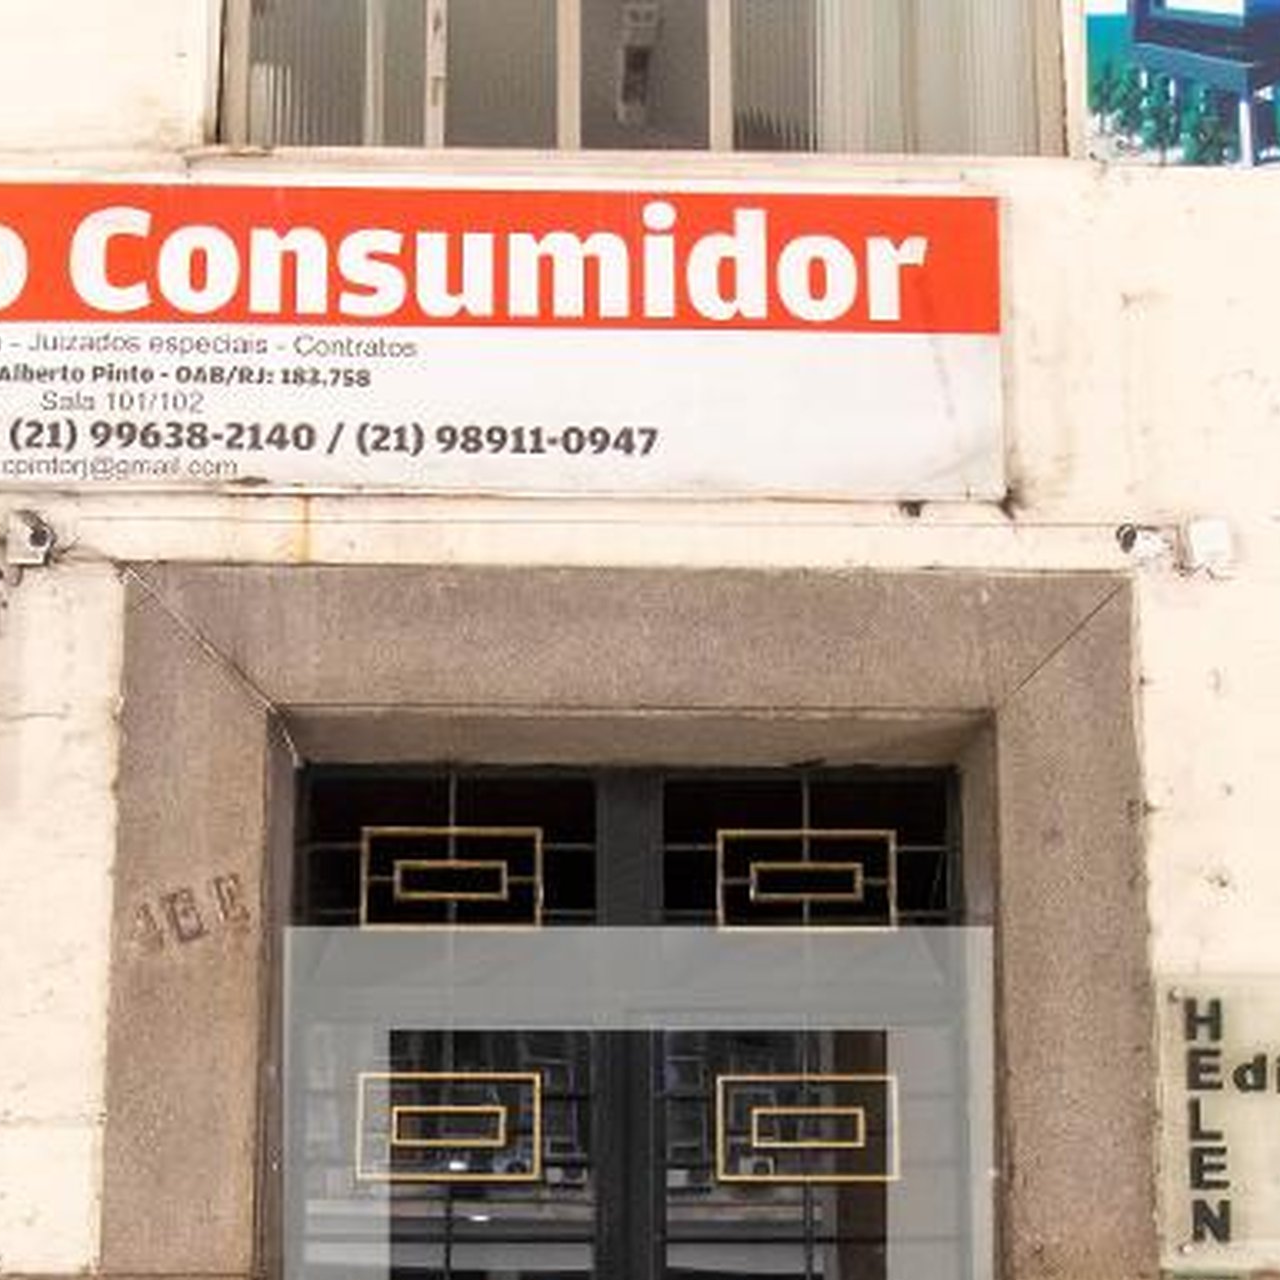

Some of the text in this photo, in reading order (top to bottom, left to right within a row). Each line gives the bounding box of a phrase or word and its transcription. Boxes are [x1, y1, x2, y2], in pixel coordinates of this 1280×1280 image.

[69, 202, 929, 321] Consumidor
[149, 334, 269, 357] especiais
[293, 334, 418, 358] Contratos
[91, 364, 154, 384] Pinto
[175, 365, 274, 386] OAB/RJ:
[40, 390, 204, 413] Sala 101/102
[9, 417, 78, 452] (21)
[90, 420, 316, 451] 99638-2140
[355, 422, 425, 457] (21)
[435, 424, 658, 456] 98911-0947
[1183, 997, 1232, 1243] HELEN
